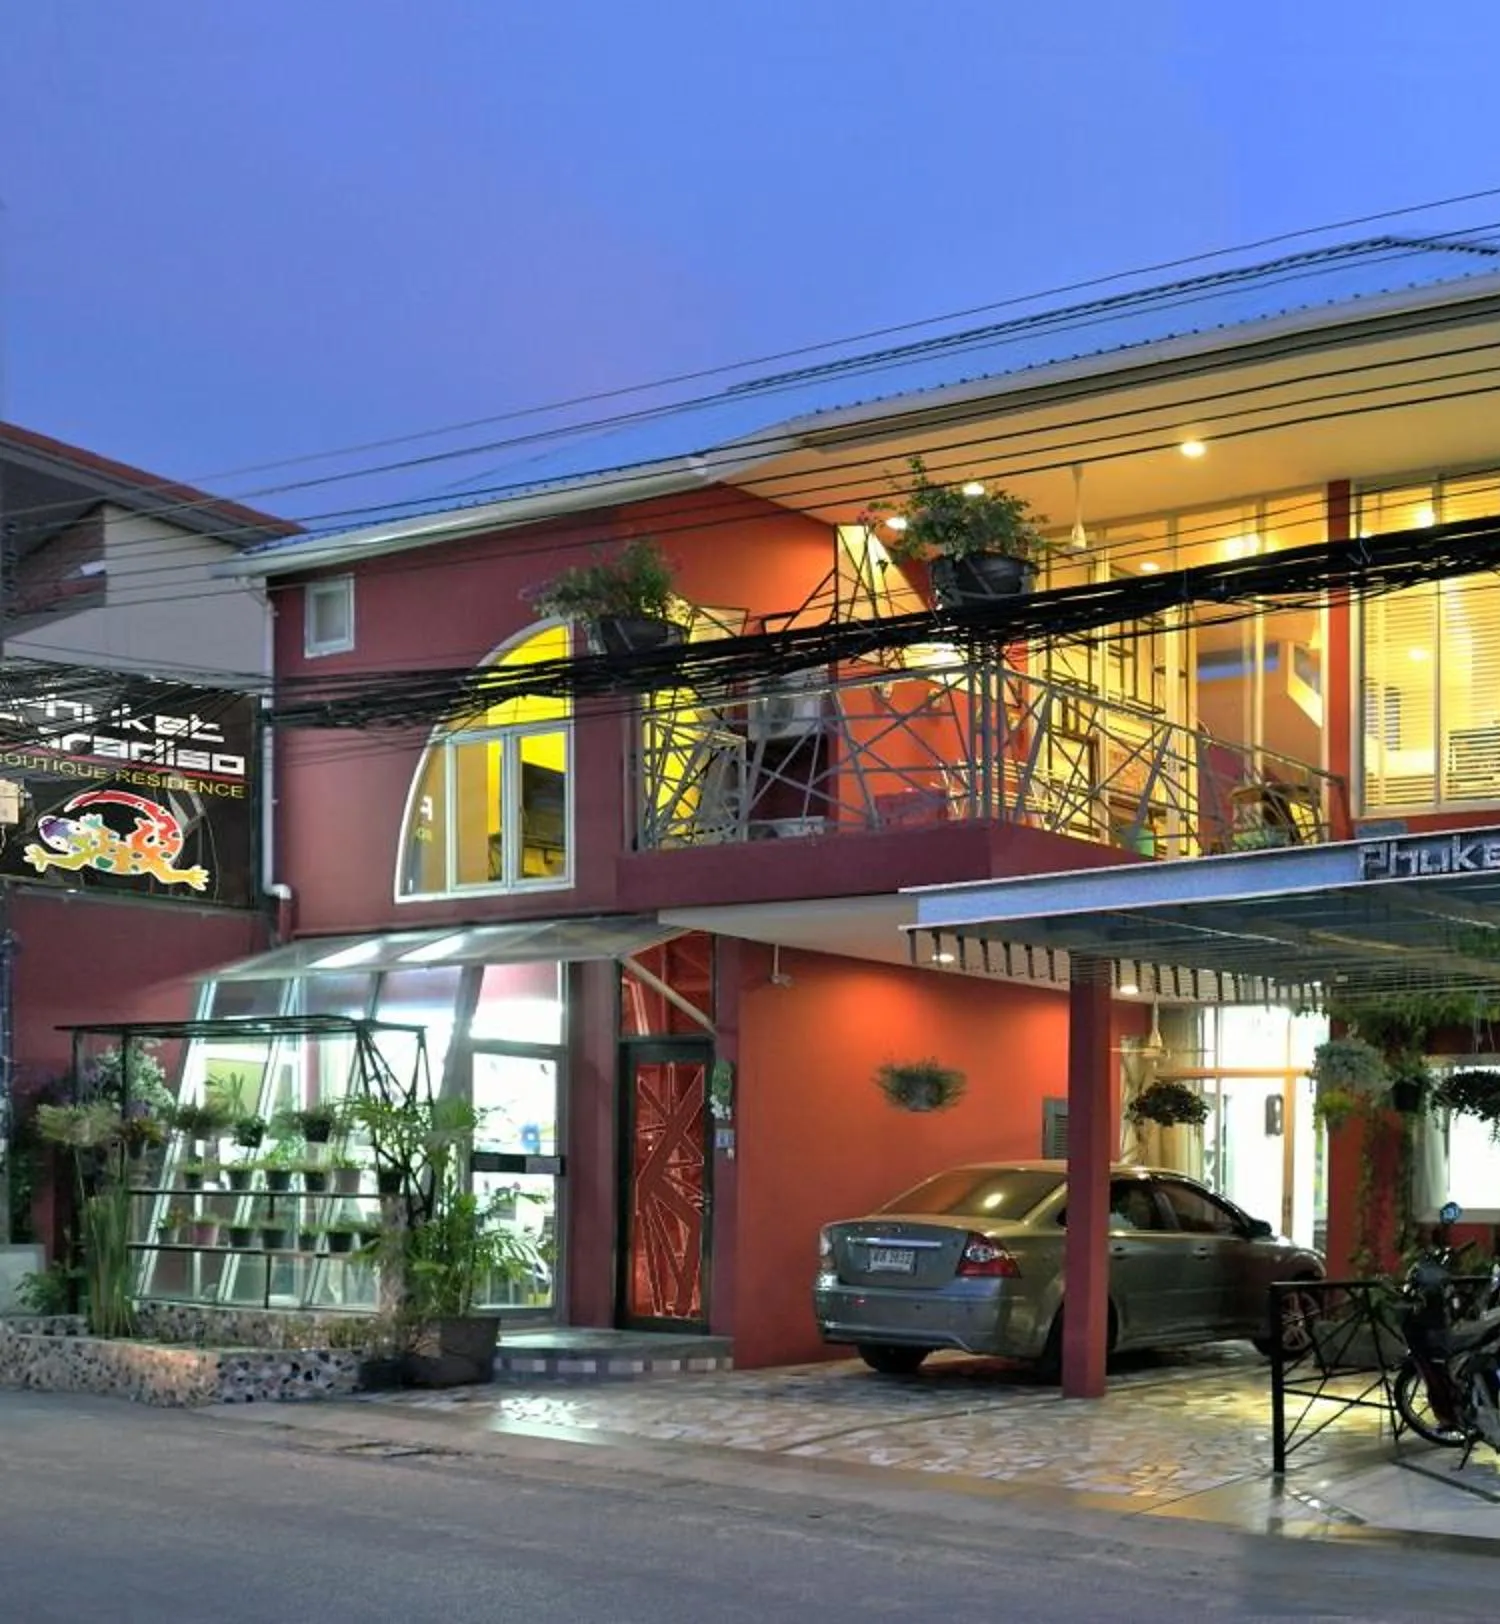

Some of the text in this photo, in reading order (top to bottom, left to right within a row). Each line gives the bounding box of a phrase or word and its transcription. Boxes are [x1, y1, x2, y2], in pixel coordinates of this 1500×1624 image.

[0, 714, 245, 776] radiso
[0, 753, 244, 798] OUTIQUE RESIDENCE
